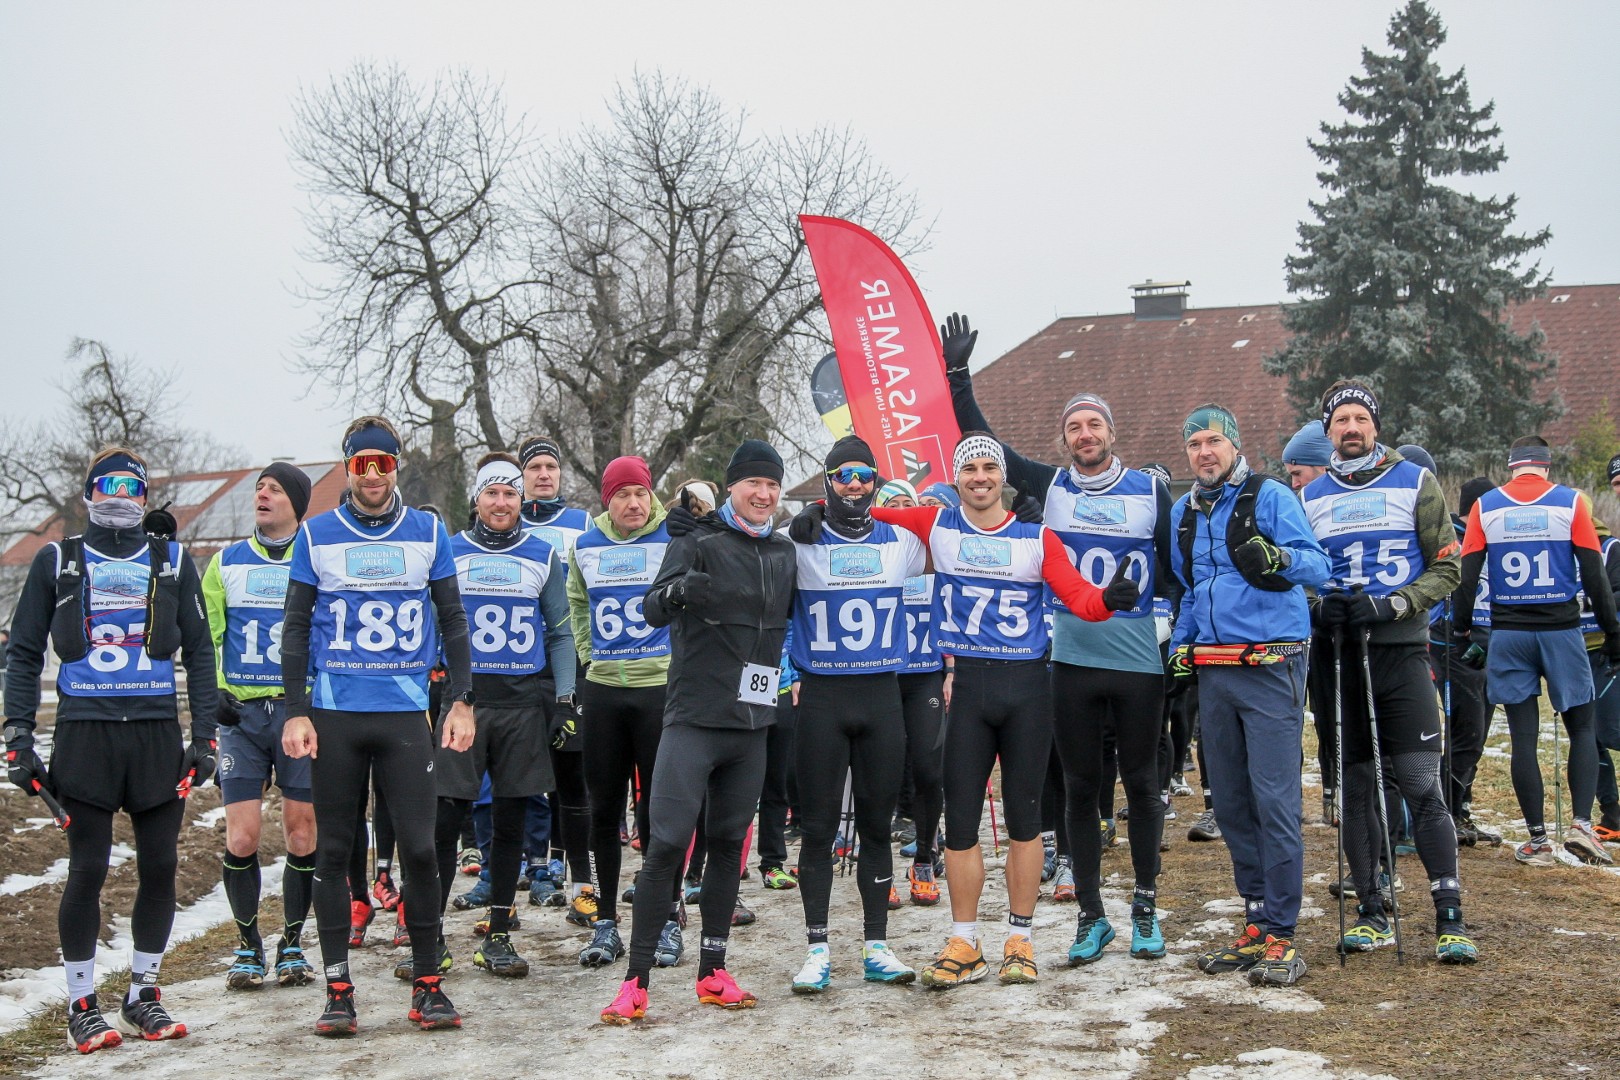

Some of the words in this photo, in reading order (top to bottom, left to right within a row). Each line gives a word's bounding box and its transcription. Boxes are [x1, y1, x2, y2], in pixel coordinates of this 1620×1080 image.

[1327, 389, 1376, 414] TERREX
[1069, 524, 1130, 534] www.gmundner-milch.at
[963, 542, 1008, 550] GMUNDNER
[954, 567, 1012, 576] www.gmundner-milch.at
[1323, 540, 1410, 586] 15
[1502, 550, 1554, 587] 91
[110, 576, 136, 584] MILCH
[328, 598, 424, 652] 189
[810, 597, 898, 652] 197
[940, 584, 1028, 638] 175
[88, 624, 152, 672] 87
[937, 640, 956, 648] Gutes
